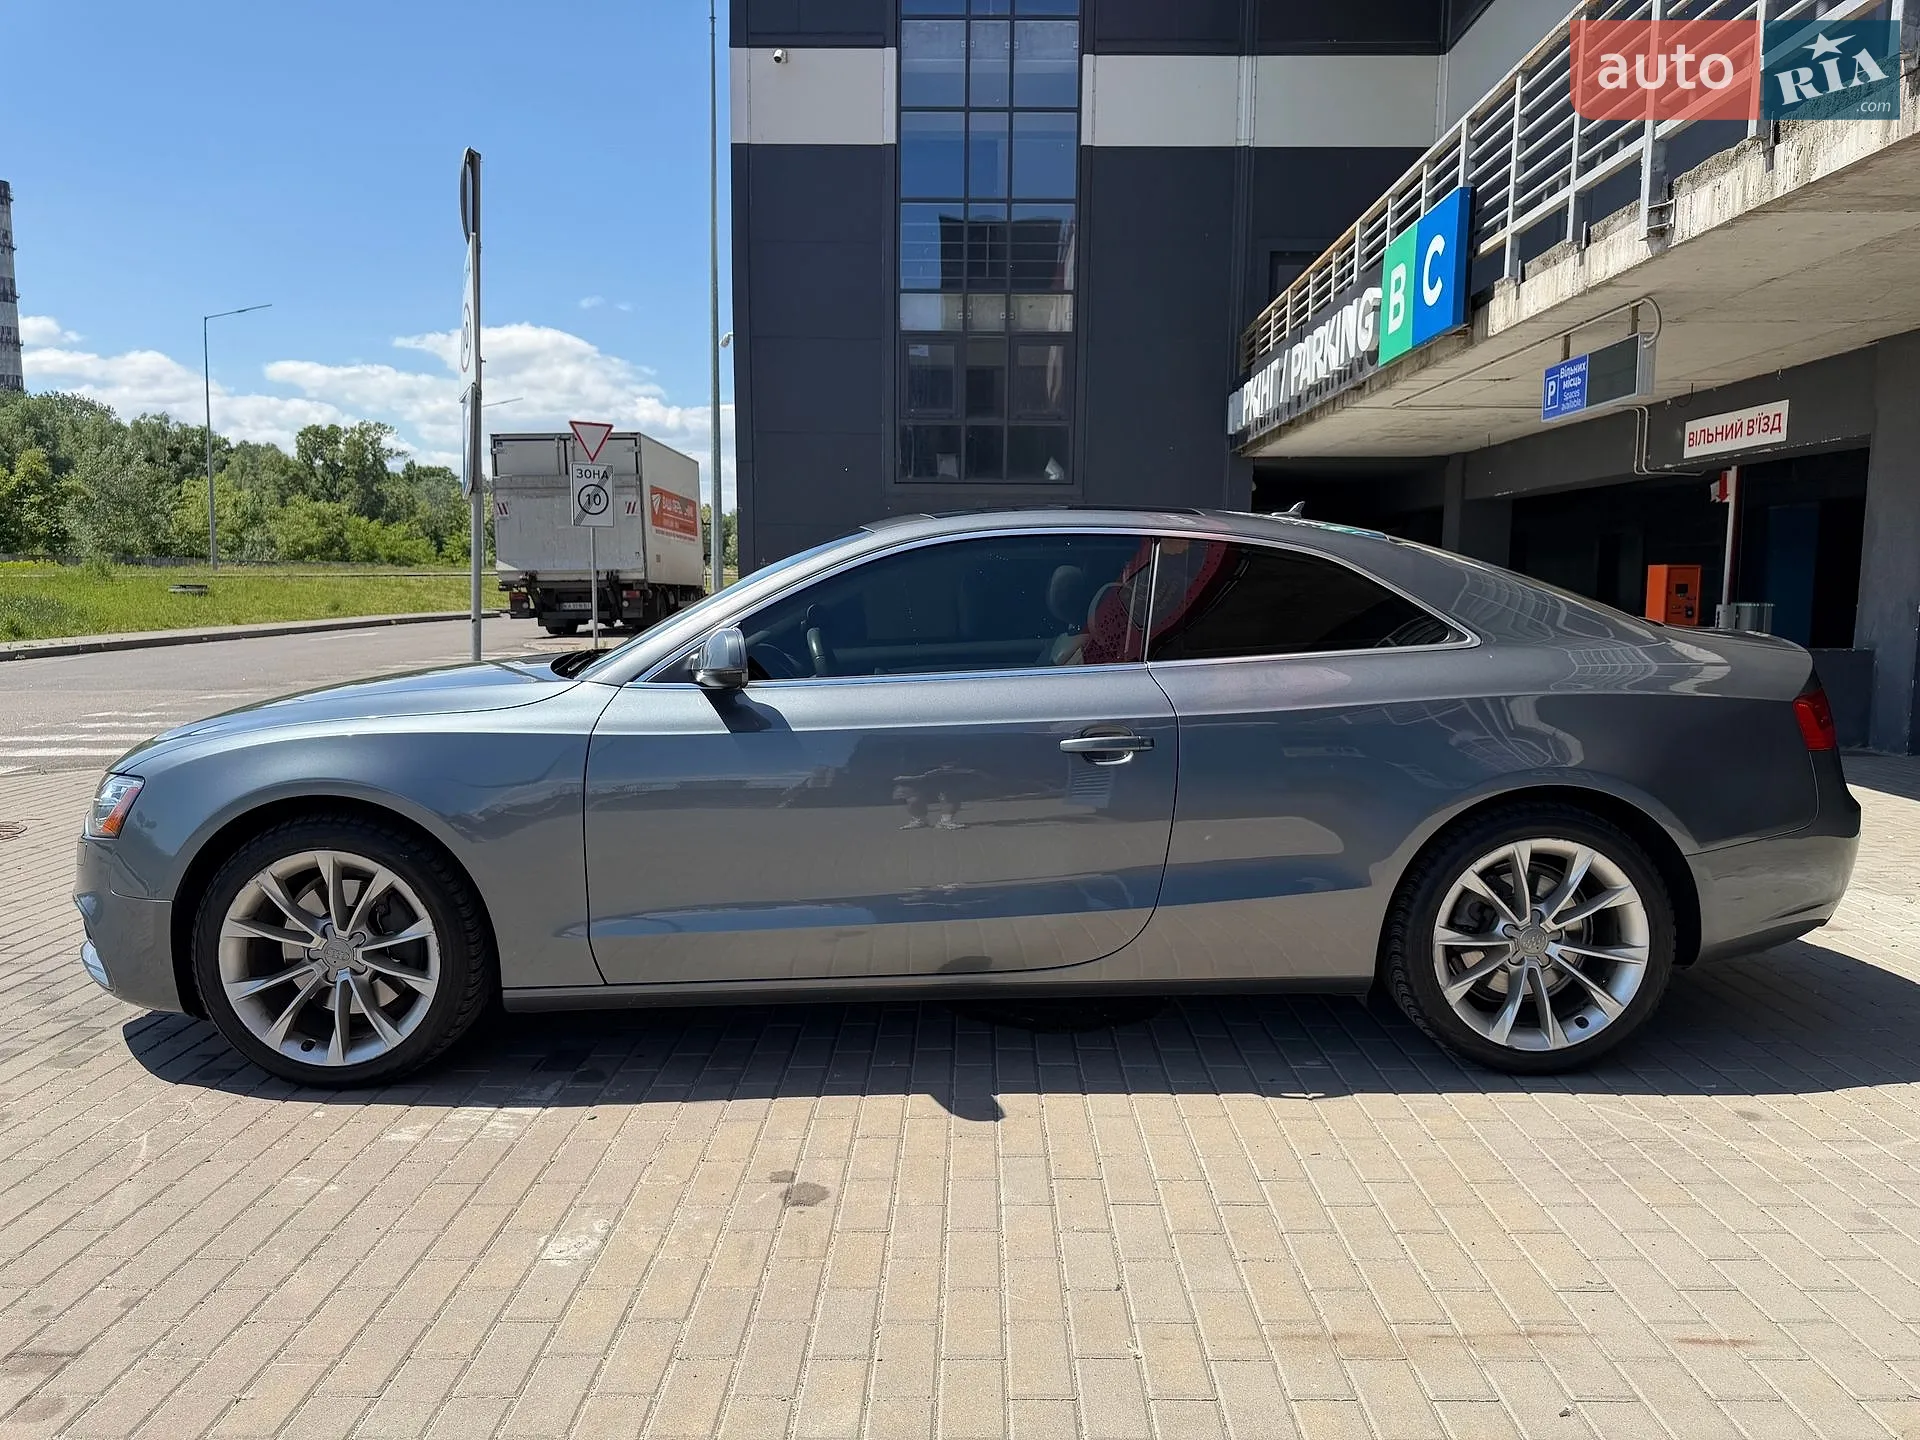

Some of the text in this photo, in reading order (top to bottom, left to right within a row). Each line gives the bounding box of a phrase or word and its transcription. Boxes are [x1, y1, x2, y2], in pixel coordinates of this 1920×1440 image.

[1387, 234, 1446, 336] B C
[1290, 287, 1383, 397] PARKING
[1560, 362, 1587, 379] Вільних
[1547, 380, 1557, 406] P
[1562, 375, 1582, 390] місць
[1688, 412, 1782, 448] ВІЛЬНИЙ В'ЇЗД
[576, 468, 609, 480] ЗОНА
[585, 492, 602, 506] 10
